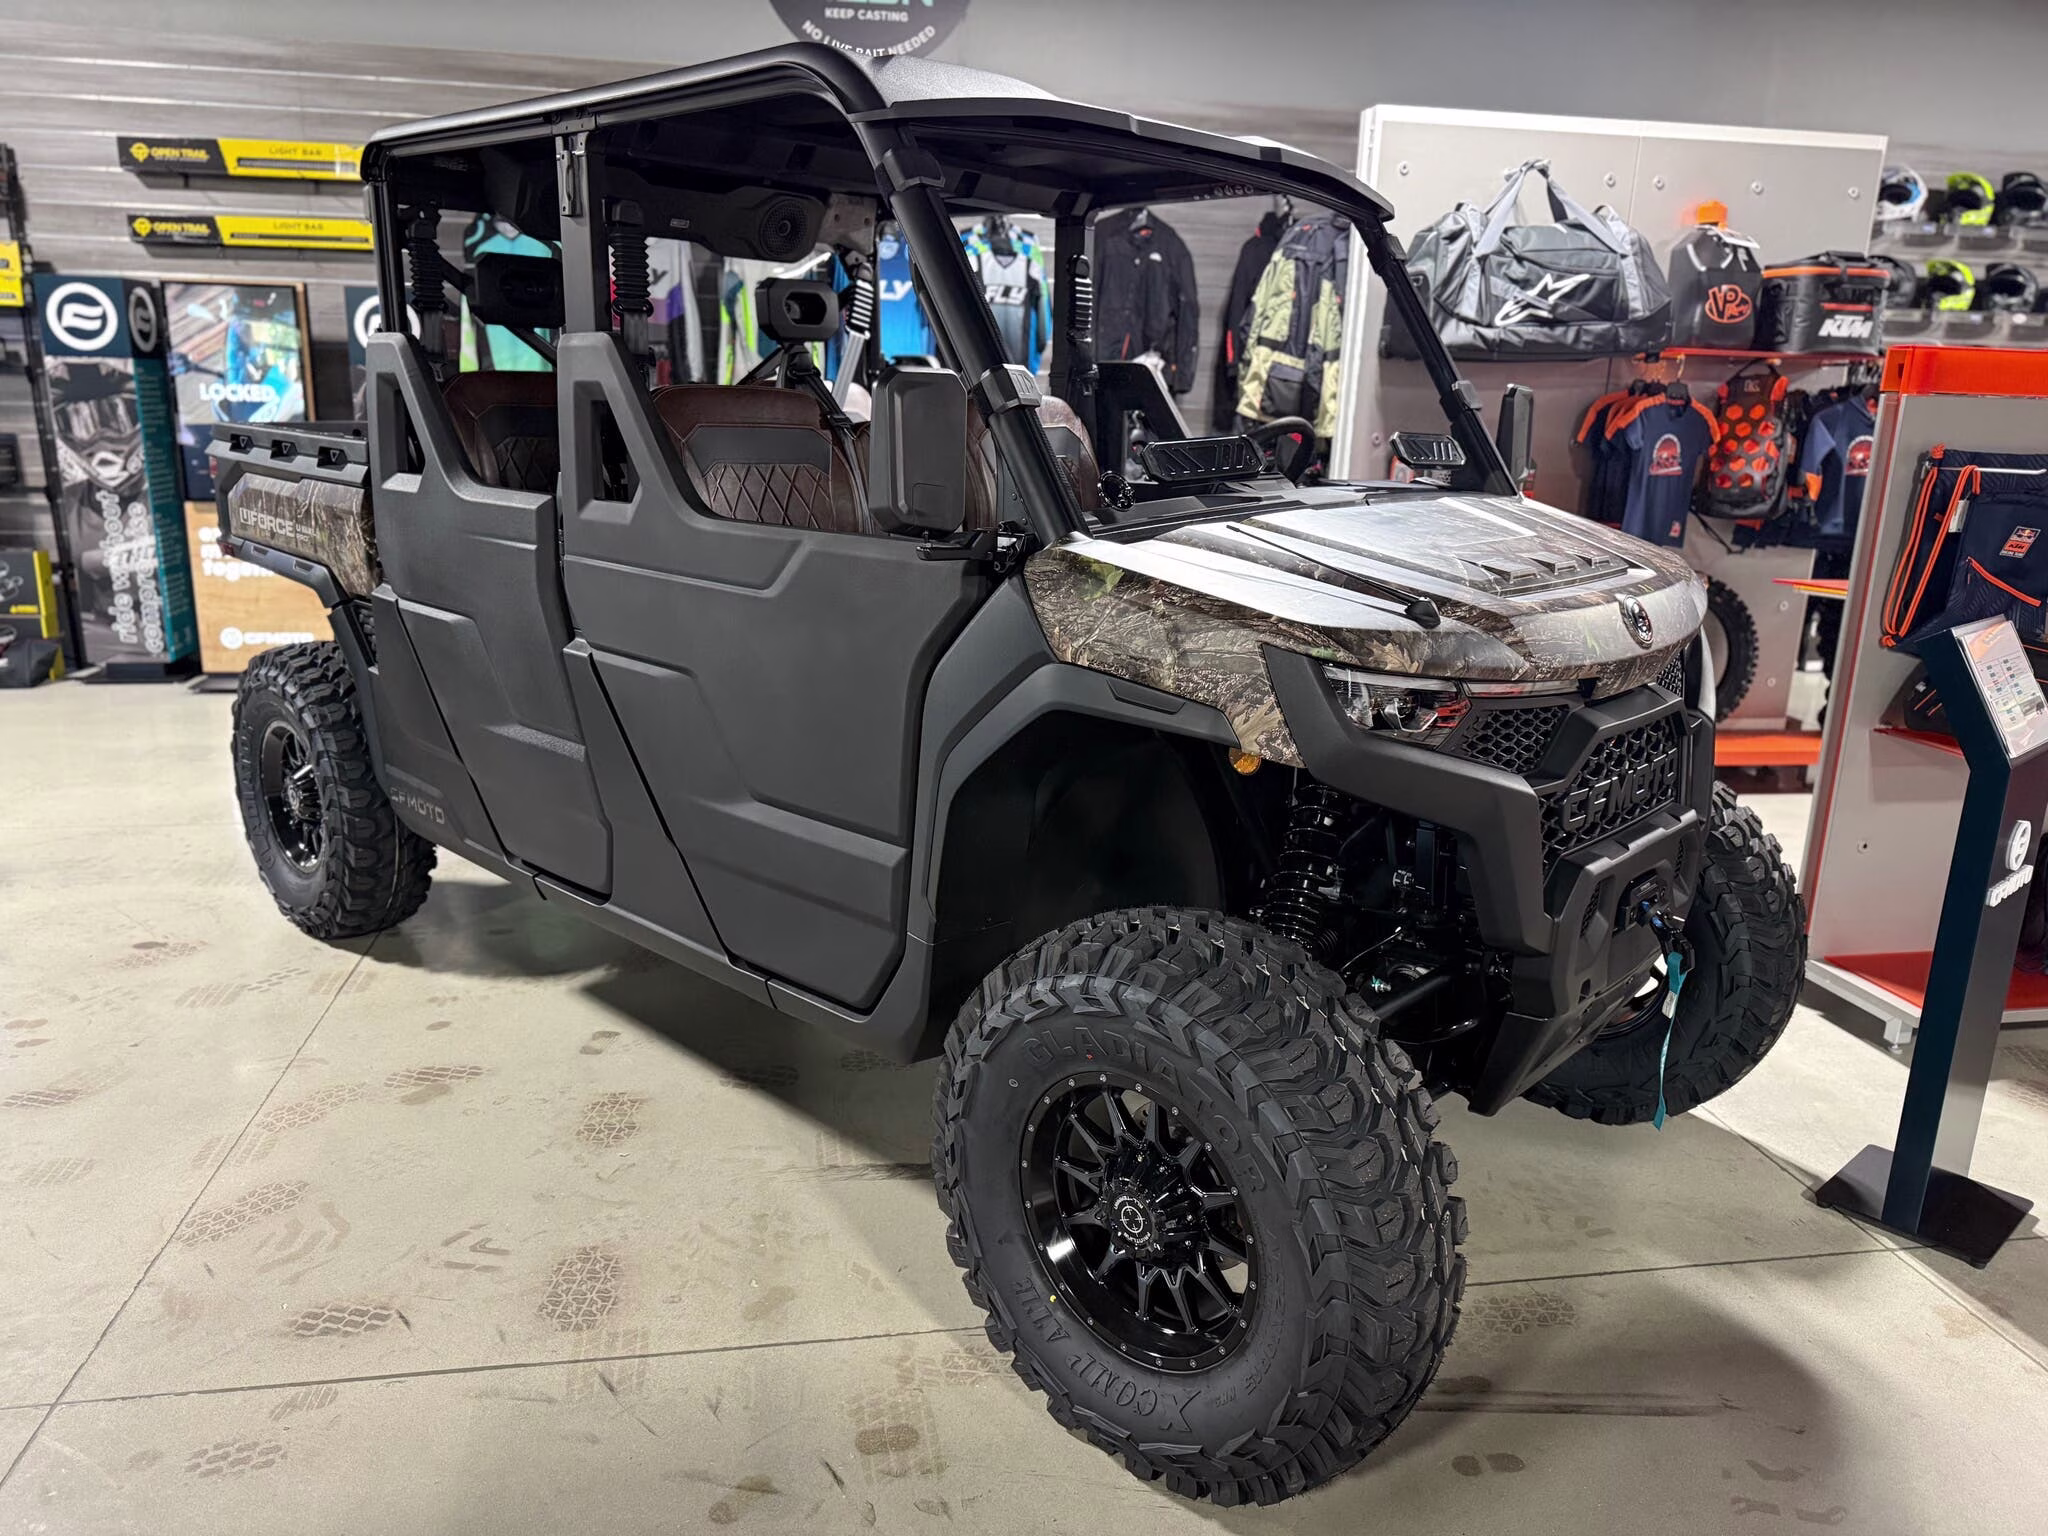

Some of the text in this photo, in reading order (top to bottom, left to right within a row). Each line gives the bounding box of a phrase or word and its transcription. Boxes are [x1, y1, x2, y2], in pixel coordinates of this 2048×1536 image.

[825, 7, 909, 23] KEEP CASTING
[802, 19, 823, 40] NO
[888, 25, 935, 56] NEEDED
[151, 147, 180, 157] OPEN
[181, 148, 209, 159] TRAIL
[269, 147, 322, 156] LIGHT BAR
[153, 222, 210, 234] OPEN TRAIL
[273, 221, 323, 231] LIGHT BAR
[879, 280, 912, 301] LY
[985, 286, 1028, 305] FLY
[1708, 284, 1743, 321] VP
[1818, 314, 1874, 338] KTM
[199, 382, 276, 402] LOCKED
[239, 507, 296, 538] UFORCE
[95, 490, 138, 644] ride without
[124, 501, 164, 653] compromise
[1563, 747, 1678, 832] CFMOTO
[389, 786, 446, 825] CFMOTO
[1022, 1026, 1267, 1193] GLADIATOR
[1015, 1277, 1202, 1432] X COMP ATR
